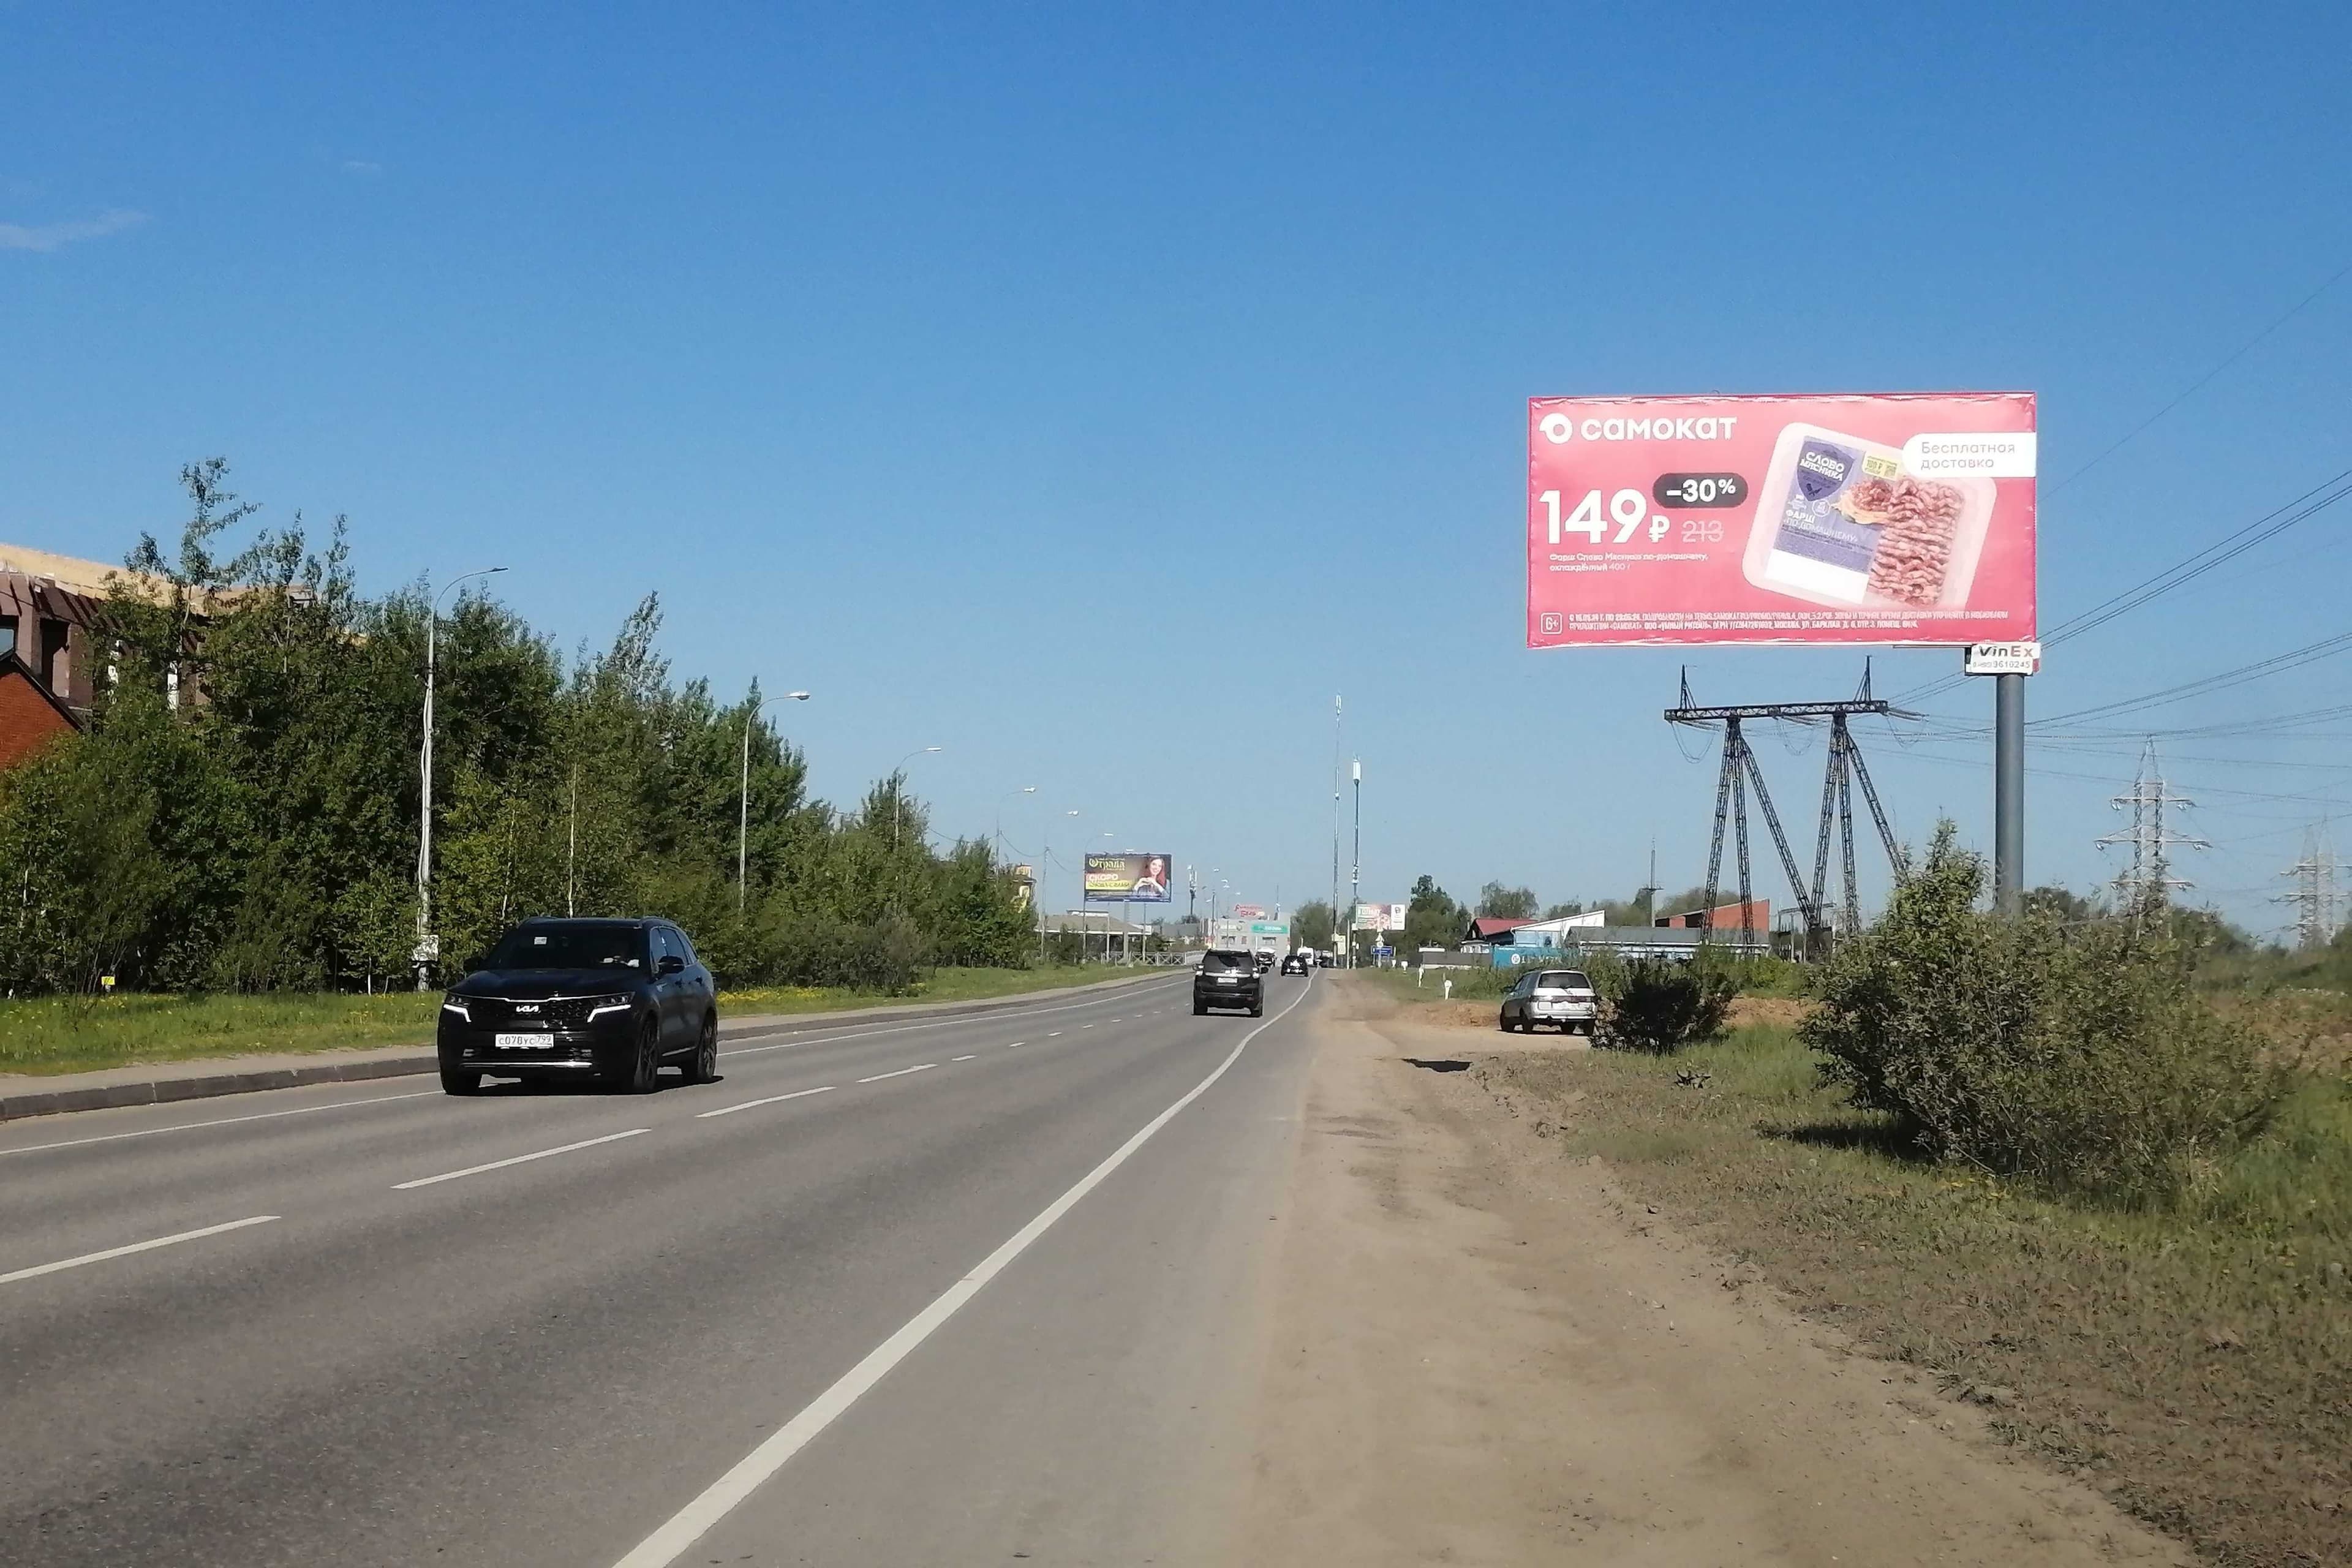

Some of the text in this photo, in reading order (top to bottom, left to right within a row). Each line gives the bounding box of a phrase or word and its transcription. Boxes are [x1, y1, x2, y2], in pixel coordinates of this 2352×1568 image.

[1580, 417, 1738, 441] самокат
[1921, 442, 2015, 454] Бесплатная
[1806, 451, 1845, 472] СЛОВО
[1921, 459, 1994, 470] доставка
[1786, 509, 1815, 524] ФАРШ
[1682, 520, 1724, 543] 213
[1545, 617, 1559, 631] 6+
[1979, 646, 2034, 657] VinEx
